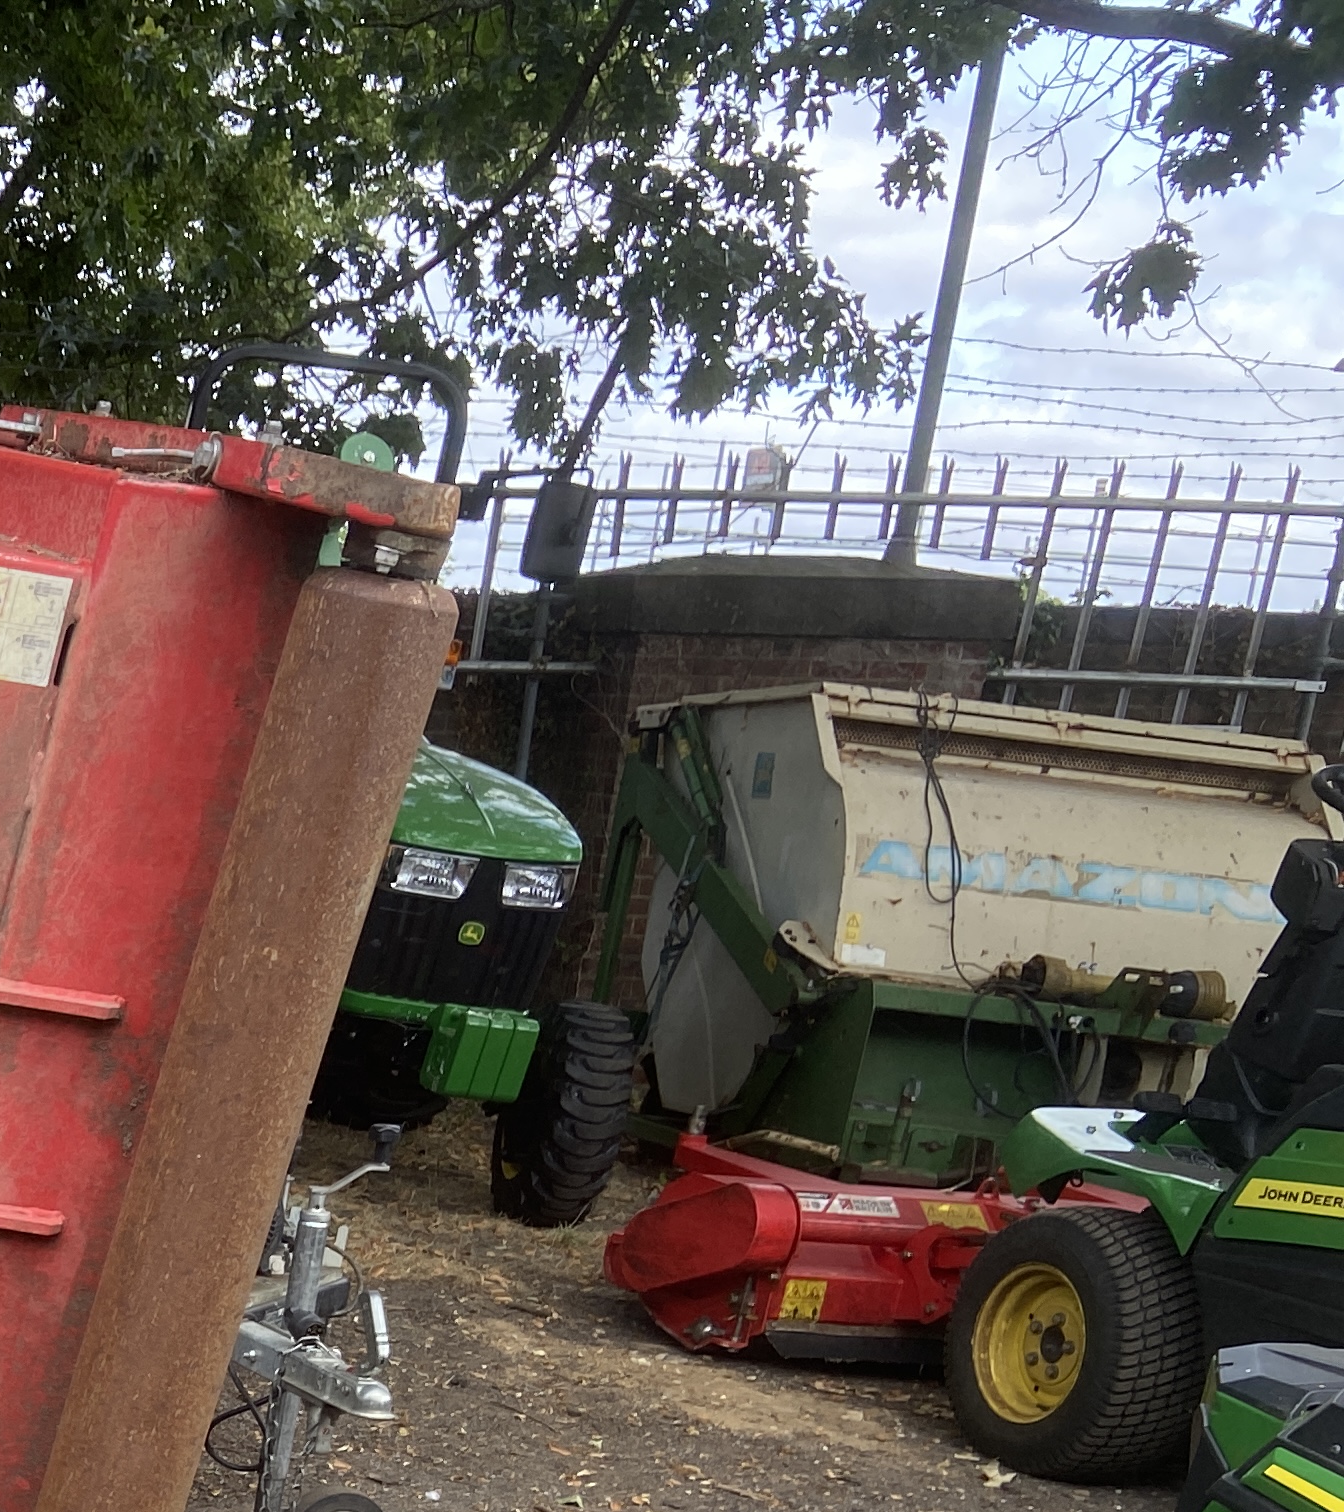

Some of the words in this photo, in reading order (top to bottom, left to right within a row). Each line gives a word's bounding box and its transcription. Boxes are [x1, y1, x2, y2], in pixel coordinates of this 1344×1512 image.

[858, 838, 1288, 925] AMAZON
[1257, 1186, 1299, 1202] JOHN
[1301, 1191, 1344, 1209] DEER
